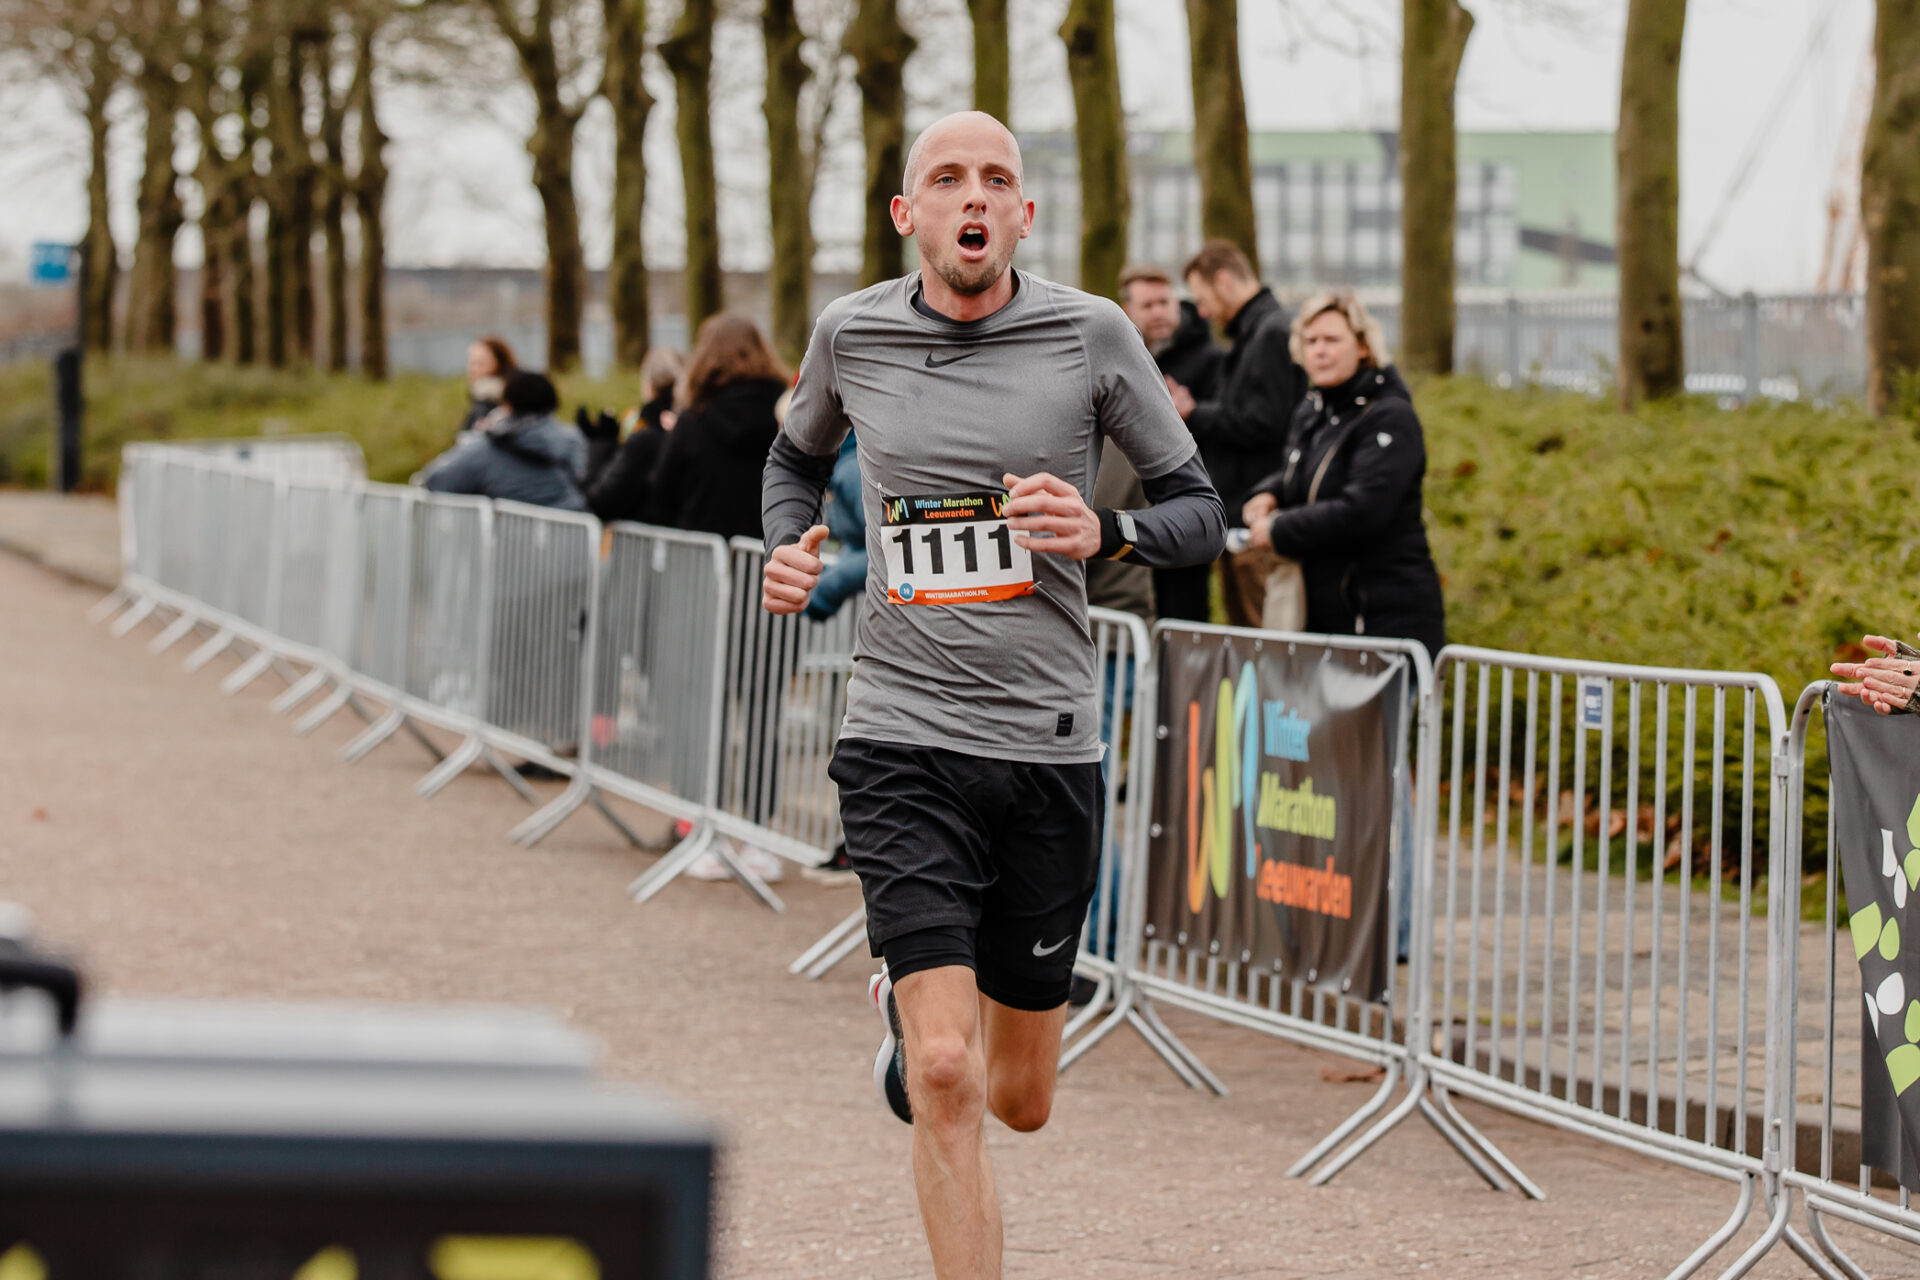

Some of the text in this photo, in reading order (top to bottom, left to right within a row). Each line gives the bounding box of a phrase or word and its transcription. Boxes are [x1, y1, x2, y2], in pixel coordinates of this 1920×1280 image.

[915, 497, 983, 509] Winter Marathon
[924, 509, 975, 519] Leeuwarden
[892, 524, 1012, 574] 1111
[1263, 700, 1311, 762] Winter
[1256, 771, 1336, 840] Marathon
[1256, 843, 1351, 919] Leeuwarden
